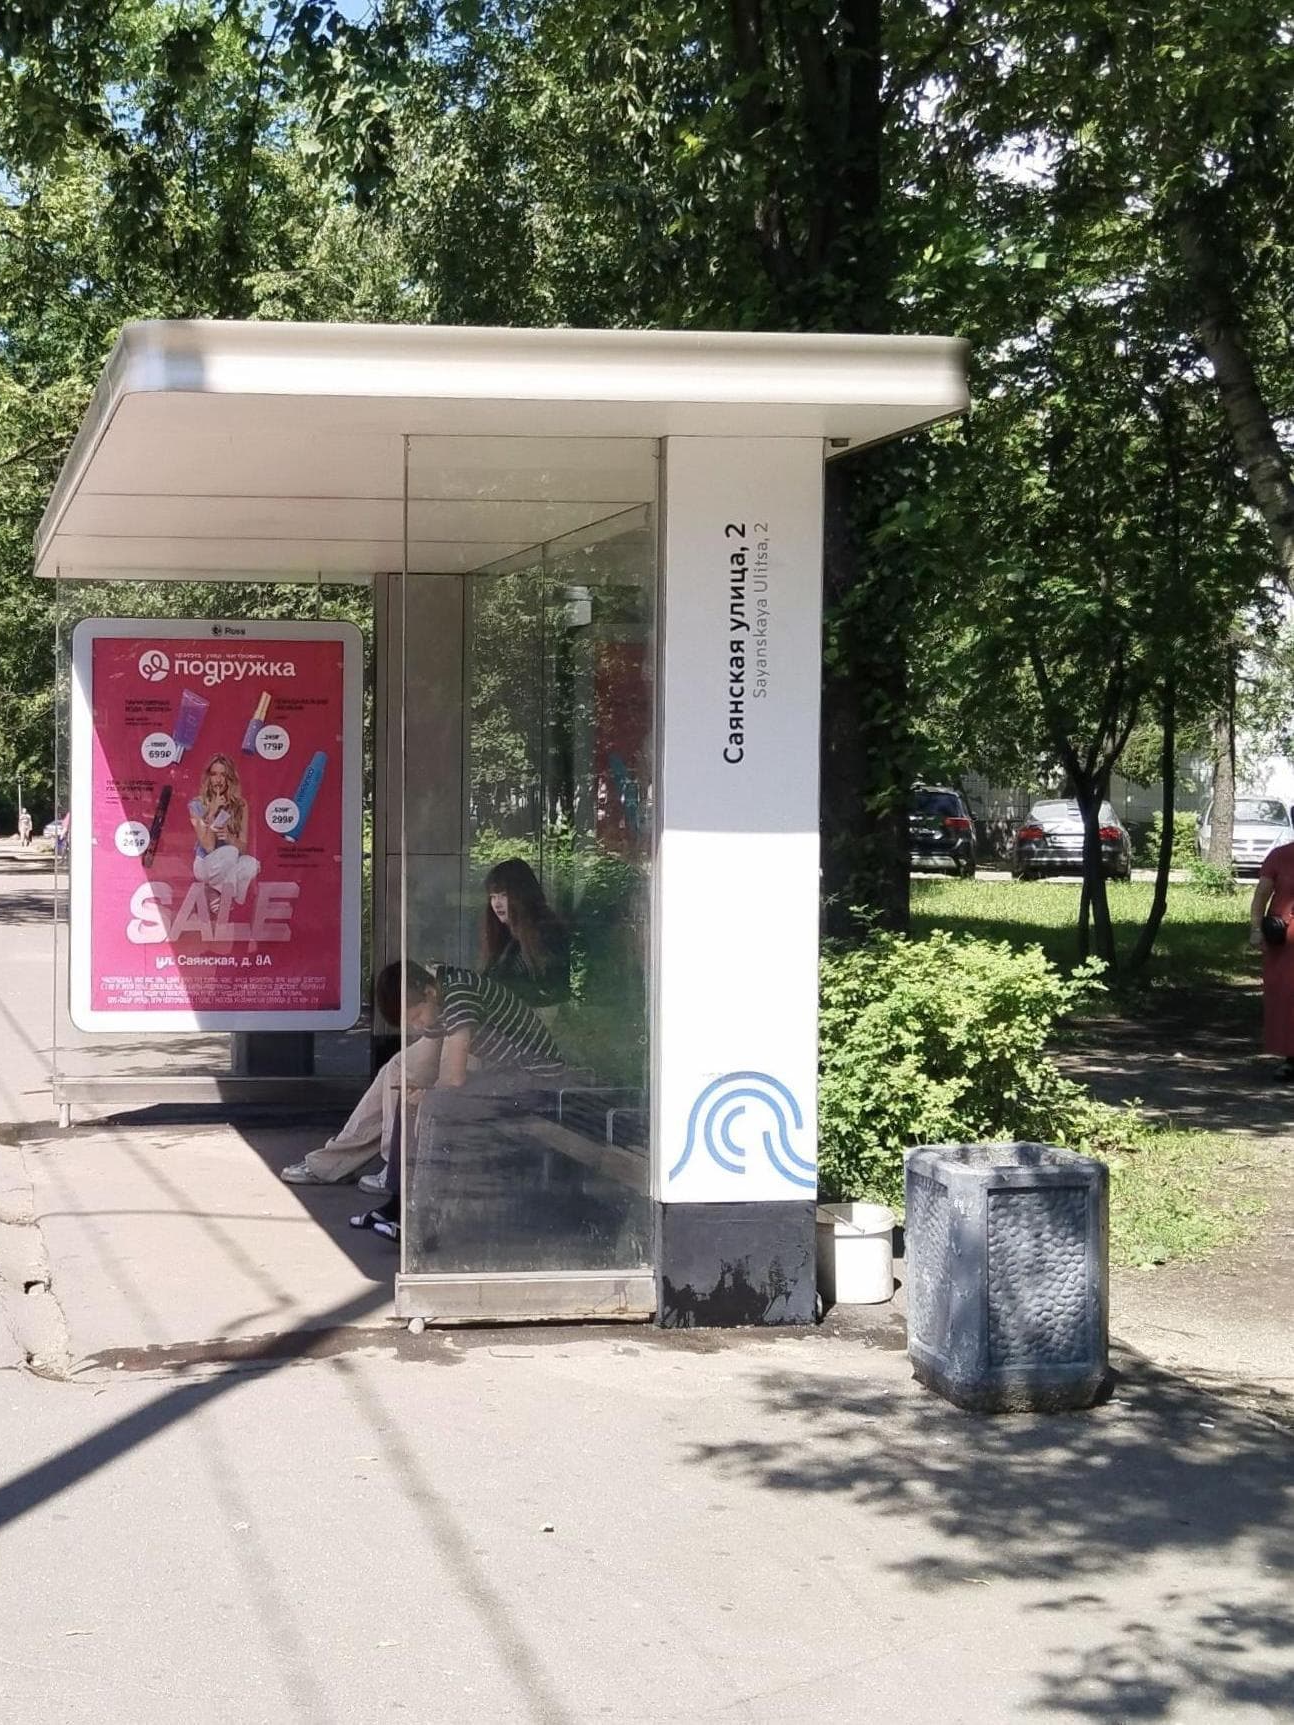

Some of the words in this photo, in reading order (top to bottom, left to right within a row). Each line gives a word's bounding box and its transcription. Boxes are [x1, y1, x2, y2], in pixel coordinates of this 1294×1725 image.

[725, 522, 746, 538] 2
[753, 522, 768, 533] 2
[730, 546, 750, 632] улица,
[753, 537, 770, 593] Ulitsa,
[174, 659, 296, 687] подружка
[753, 598, 771, 698] Sayanskaya
[723, 640, 745, 764] Саянская
[126, 881, 300, 944] SALE
